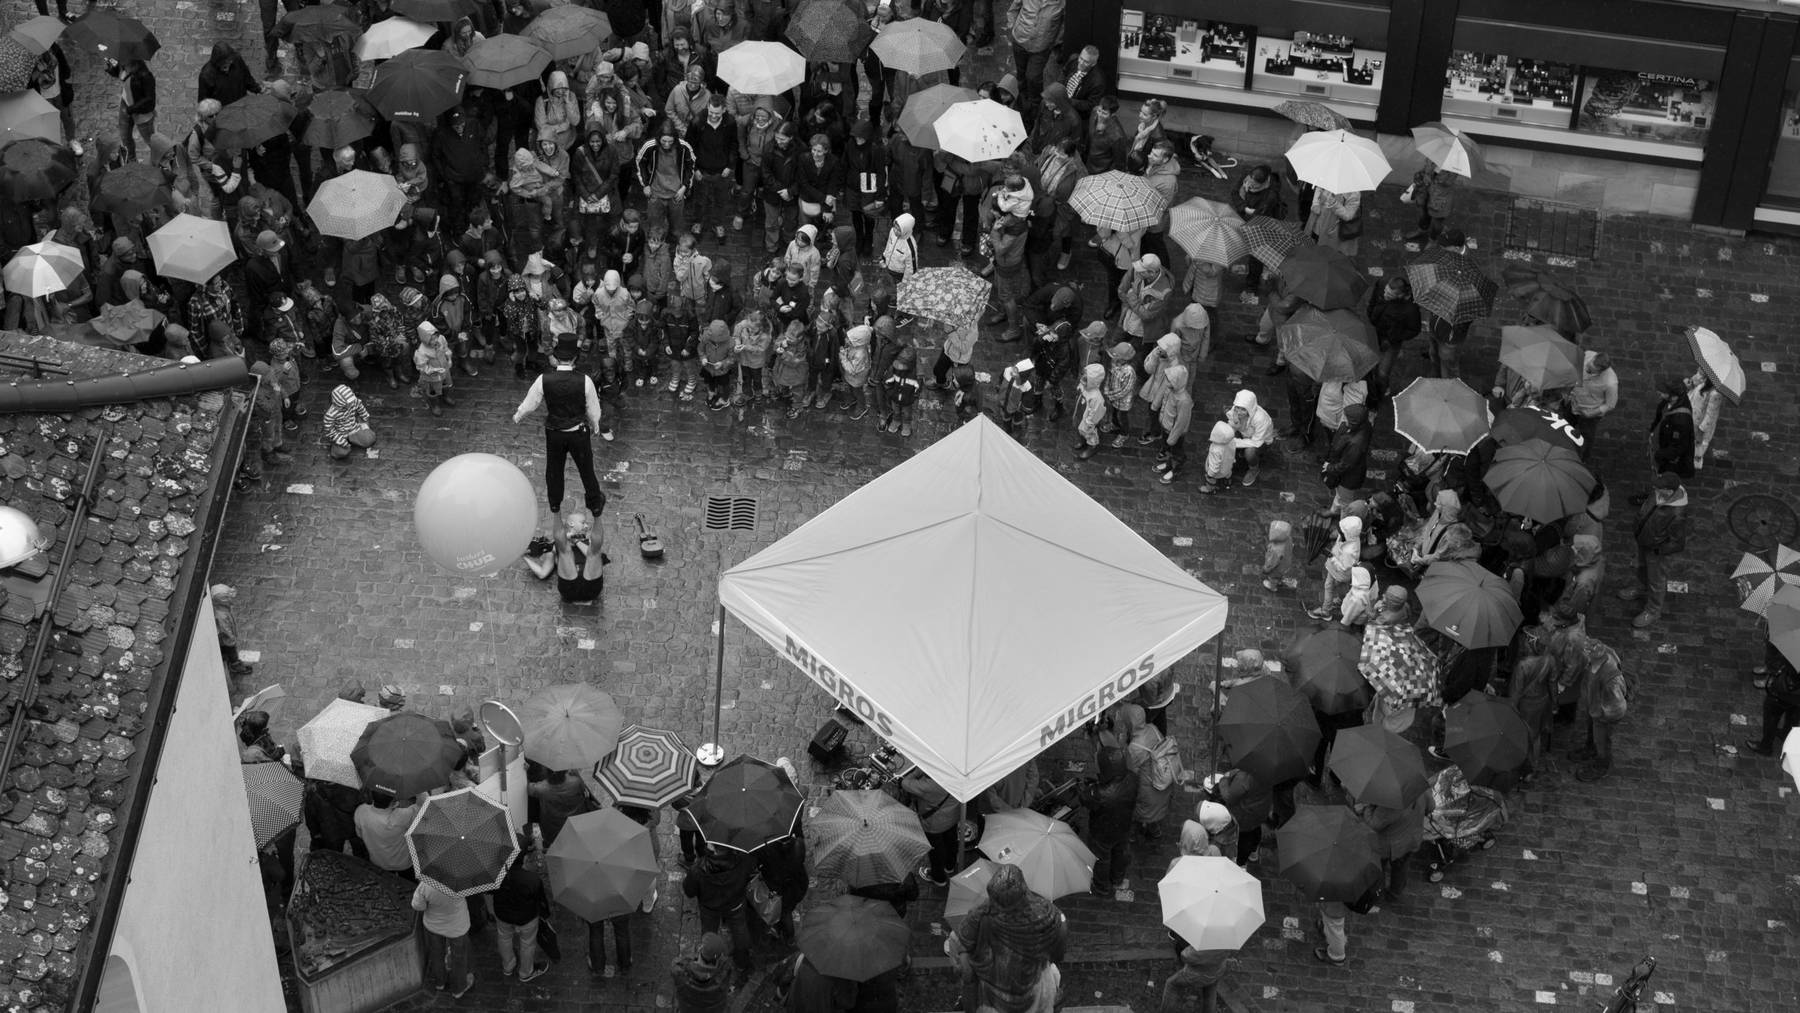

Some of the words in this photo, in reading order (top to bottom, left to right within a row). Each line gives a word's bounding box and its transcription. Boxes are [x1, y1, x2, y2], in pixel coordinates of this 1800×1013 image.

[1638, 72, 1695, 84] CERTINA
[785, 634, 894, 737] MIGROS
[1040, 653, 1155, 748] MIGROS
